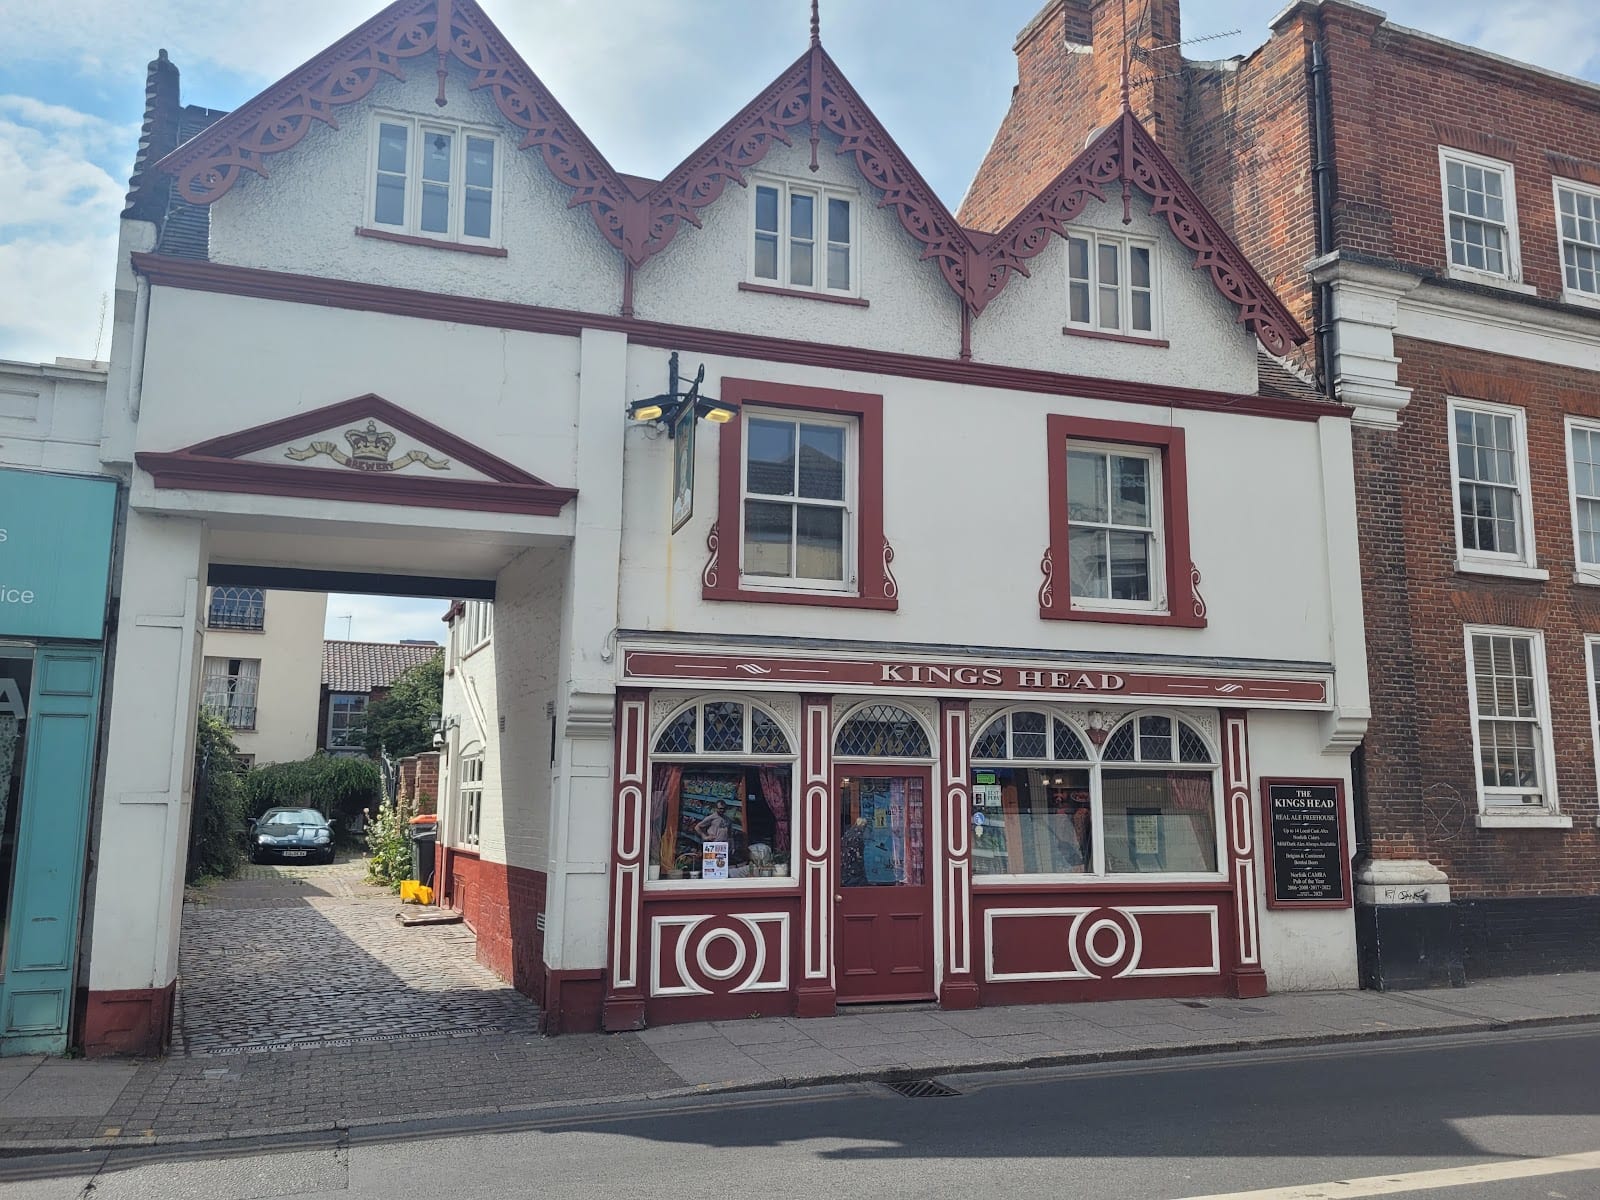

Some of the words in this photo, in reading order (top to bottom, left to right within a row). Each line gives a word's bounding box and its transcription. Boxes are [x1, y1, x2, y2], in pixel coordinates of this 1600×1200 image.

[345, 457, 394, 472] BREWERY
[880, 663, 1003, 686] KINGS
[1017, 670, 1126, 691] HEAD
[1274, 798, 1305, 808] KINGS
[1307, 799, 1334, 808] HEAD
